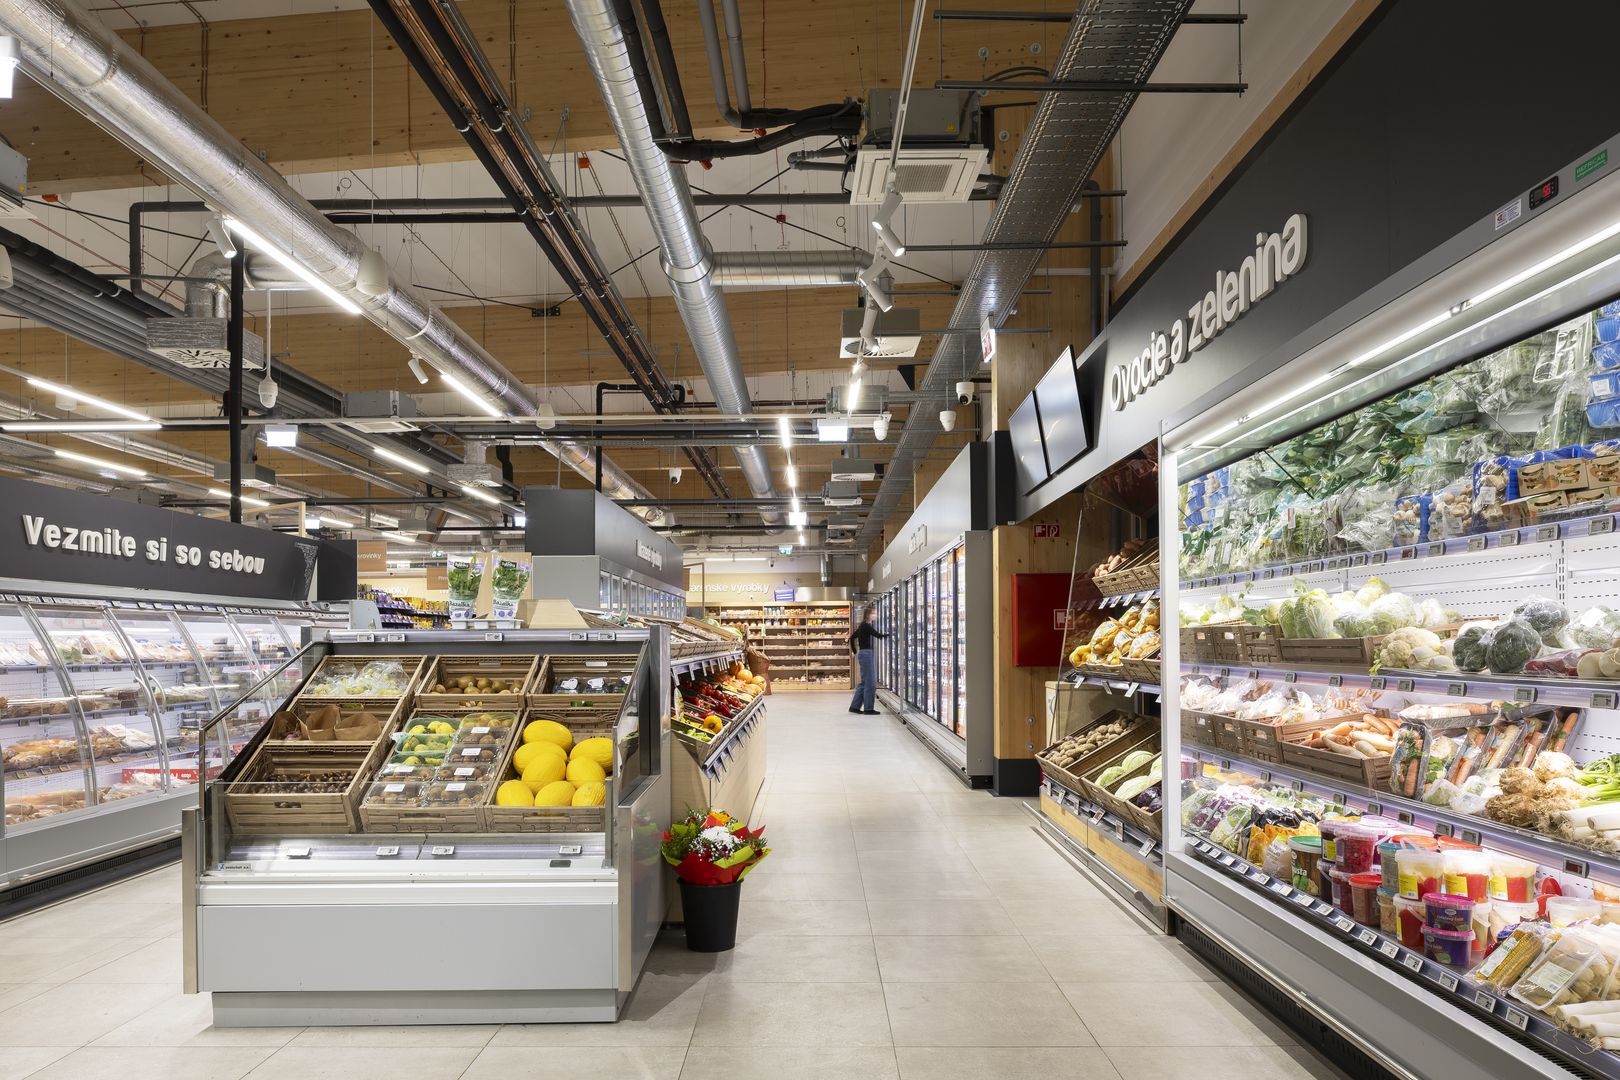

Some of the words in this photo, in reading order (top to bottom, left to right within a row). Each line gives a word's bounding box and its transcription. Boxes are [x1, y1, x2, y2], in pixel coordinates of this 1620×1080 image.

[1111, 331, 1170, 412] Ovocie
[1170, 319, 1189, 364] a
[1187, 213, 1308, 353] zelenina
[22, 514, 136, 558] Vezmite
[145, 537, 167, 562] si
[175, 543, 202, 566] so
[208, 549, 266, 576] sebou
